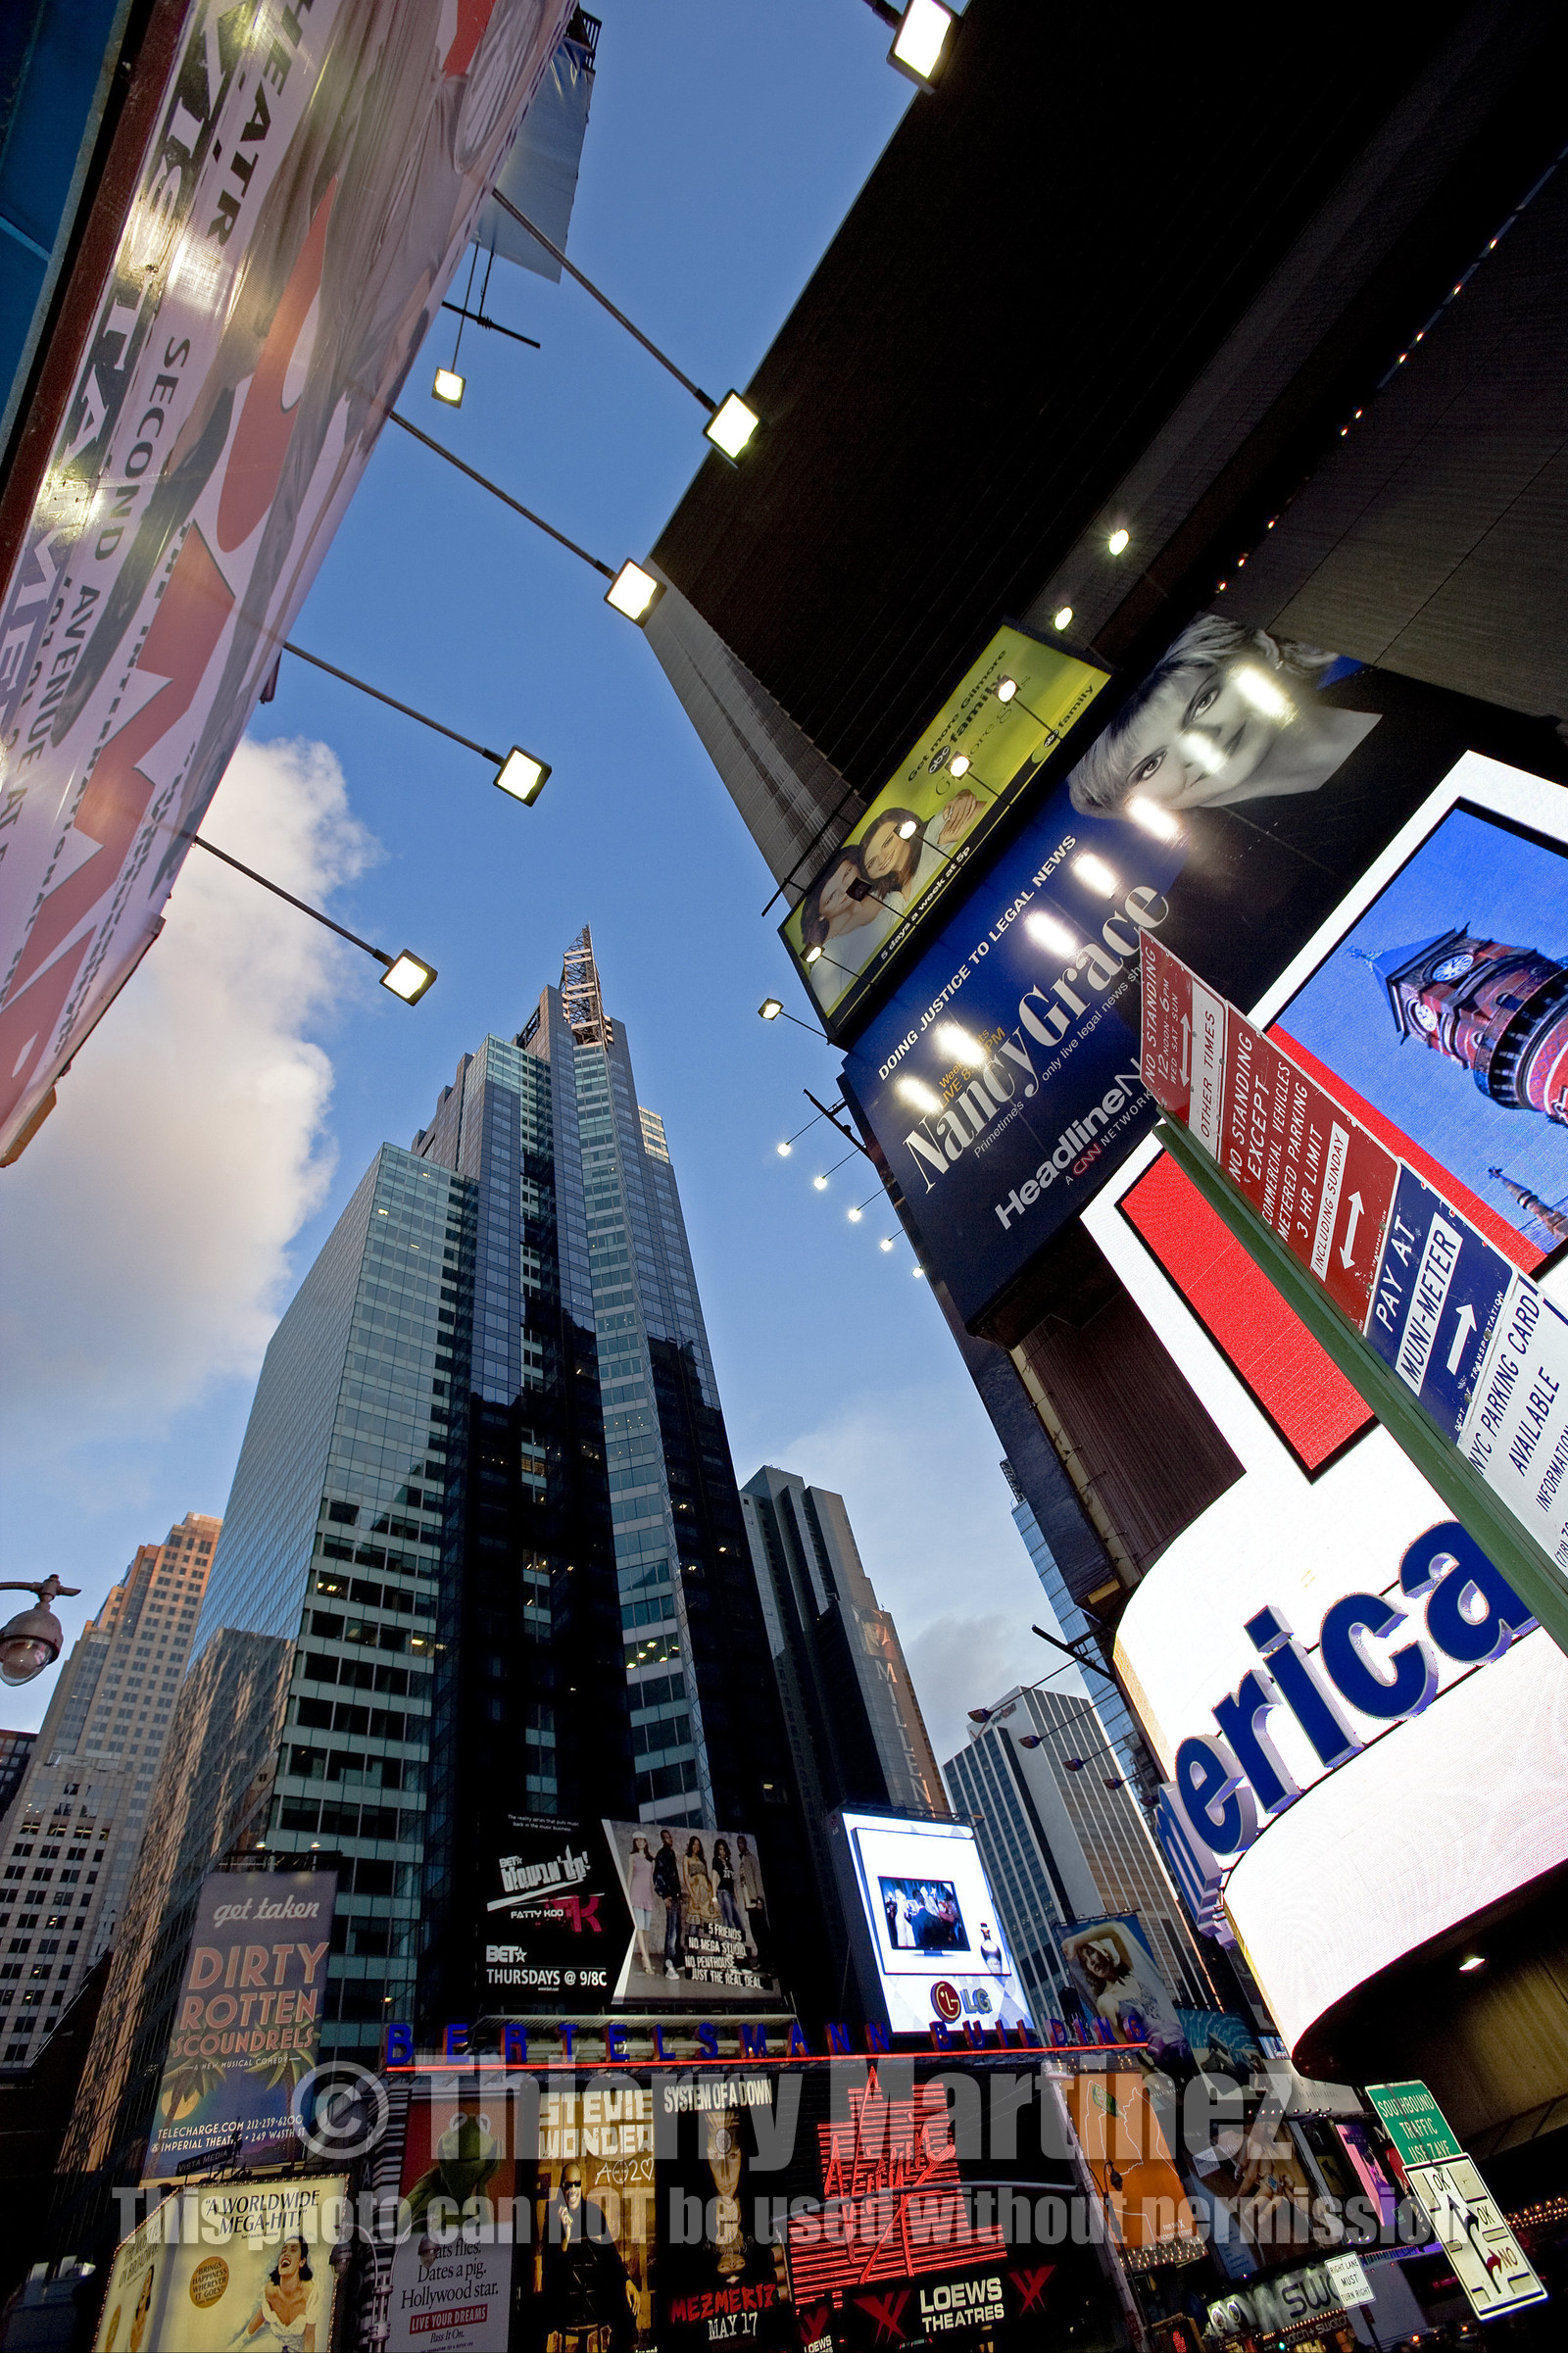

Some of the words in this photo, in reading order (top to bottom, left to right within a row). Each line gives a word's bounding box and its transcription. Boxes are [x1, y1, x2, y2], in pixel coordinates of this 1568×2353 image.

[95, 336, 191, 562] SECOND
[154, 521, 191, 600] THE
[17, 585, 101, 773] AVENUE
[907, 754, 929, 782] Get
[929, 712, 960, 753] more
[960, 649, 1007, 711] Gilmore
[1057, 684, 1095, 729] family
[929, 745, 951, 774] abc
[24, 625, 150, 932] INTERNATIONAL
[880, 949, 889, 960] 5
[888, 921, 912, 953] days
[910, 910, 919, 923] a
[917, 876, 947, 912] week
[945, 861, 958, 883] at
[878, 1027, 919, 1080] DOING
[919, 963, 972, 1032] JUSTICE
[968, 941, 991, 965] TO
[988, 889, 1036, 943] LEGAL
[1032, 835, 1078, 889] NEWS
[1144, 945, 1158, 1049] STANDING
[1171, 994, 1180, 1023] SUN
[1202, 1009, 1216, 1070] TIMES
[973, 1100, 1025, 1159] Primetime's
[1041, 1057, 1062, 1082] only
[1060, 1037, 1080, 1060] live
[1080, 1011, 1102, 1042] legal
[1102, 983, 1129, 1014] news
[1145, 1053, 1157, 1085] NO
[1157, 1057, 1169, 1081] 12
[1232, 1031, 1254, 1146] STANDING
[1200, 1075, 1214, 1139] OTHER
[1064, 1175, 1075, 1187] A
[1072, 1142, 1103, 1176] CNN
[1102, 1088, 1154, 1148] NETWORK
[1246, 1074, 1271, 1182] EXCEPT
[1261, 1138, 1283, 1227] COMMERCIAL
[1272, 1061, 1292, 1136] VEHICLES
[1227, 1148, 1244, 1184] NO
[1276, 1165, 1298, 1243] METERED
[1287, 1081, 1309, 1165] PARKING
[1307, 1122, 1324, 1186] LIMIT
[1300, 1186, 1316, 1221] HR
[1314, 1197, 1336, 1271] INCLUDING
[1326, 1131, 1348, 1196] SUNDAY
[1296, 1220, 1309, 1239] 3
[1374, 1263, 1403, 1333] PAY
[1390, 1214, 1417, 1268] AT
[1400, 1228, 1457, 1386] MUNI-METER
[1507, 1294, 1541, 1356] CARD
[1480, 1352, 1521, 1442] PARKING
[1507, 1365, 1561, 1479] AVAILABLE
[1468, 1432, 1494, 1477] NYC
[499, 1855, 517, 1869] BET
[213, 1897, 250, 1930] get
[252, 1893, 321, 1921] taken
[511, 1909, 542, 1920] FATTY
[543, 1908, 564, 1918] KOO
[688, 1936, 700, 1950] NO
[700, 1937, 720, 1953] MEGA
[708, 1924, 714, 1936] 5
[714, 1925, 742, 1941] FRIENDS
[187, 1940, 331, 1990] DIRTY
[486, 1944, 519, 1964] BET
[684, 1954, 696, 1969] NO
[486, 1968, 561, 1986] THURSDAYS
[564, 1970, 577, 1986] @
[579, 1970, 608, 1987] 9/8C
[691, 1967, 709, 1983] JUST
[710, 1971, 724, 1985] THE
[725, 1971, 743, 1987] REAL
[178, 1987, 319, 2032] ROTTEN
[958, 1987, 993, 2015] LG
[172, 2025, 317, 2059] SCOUNDRELS
[386, 2021, 891, 2065] BERTELSMANN
[201, 2062, 220, 2071] NEW
[221, 2059, 253, 2069] MUSICAL
[255, 2056, 289, 2066] COMEDY
[539, 2088, 654, 2127] STEVIE
[663, 2083, 712, 2114] SYSTEM
[711, 2083, 729, 2111] OF
[728, 2082, 739, 2108] A
[738, 2079, 773, 2107] DOWN
[1377, 2092, 1435, 2119] SOUTHBOUND
[157, 2120, 245, 2140] TELECHARGE.COM
[160, 2138, 204, 2153] IMPERIAL
[250, 2131, 267, 2143] 249
[297, 2127, 306, 2137] ST
[538, 2123, 655, 2160] WONDER
[1398, 2117, 1439, 2140] TRAFFIC
[1407, 2143, 1428, 2164] USE
[1432, 2172, 1451, 2193] OK
[221, 2189, 321, 2215] WORLDWIDE
[1477, 2205, 1496, 2226] OK
[435, 2243, 453, 2260] ats
[455, 2236, 482, 2257] flies.
[1497, 2246, 1519, 2269] NO
[192, 2269, 227, 2285] HAPPINESS
[417, 2264, 455, 2283] Dates
[456, 2265, 464, 2278] a
[465, 2257, 487, 2281] pig.
[1329, 2264, 1345, 2275] RIGHT
[1345, 2259, 1359, 2271] LANE
[1340, 2274, 1359, 2287] MUST
[192, 2277, 227, 2293] WHEREVER
[400, 2279, 473, 2311] Hollywood
[474, 2281, 500, 2298] star.
[919, 2276, 1004, 2314] LOEWS
[1341, 2290, 1355, 2302] TURN
[1354, 2285, 1371, 2298] RIGHT
[411, 2314, 431, 2332] LIVE
[431, 2310, 454, 2328] YOUR
[454, 2306, 487, 2325] DREAMS
[670, 2282, 778, 2324] MEZMERIZ
[921, 2303, 1005, 2333] THEATRES
[429, 2331, 445, 2344] Pass
[707, 2313, 738, 2341] MAY
[740, 2311, 760, 2337] 17
